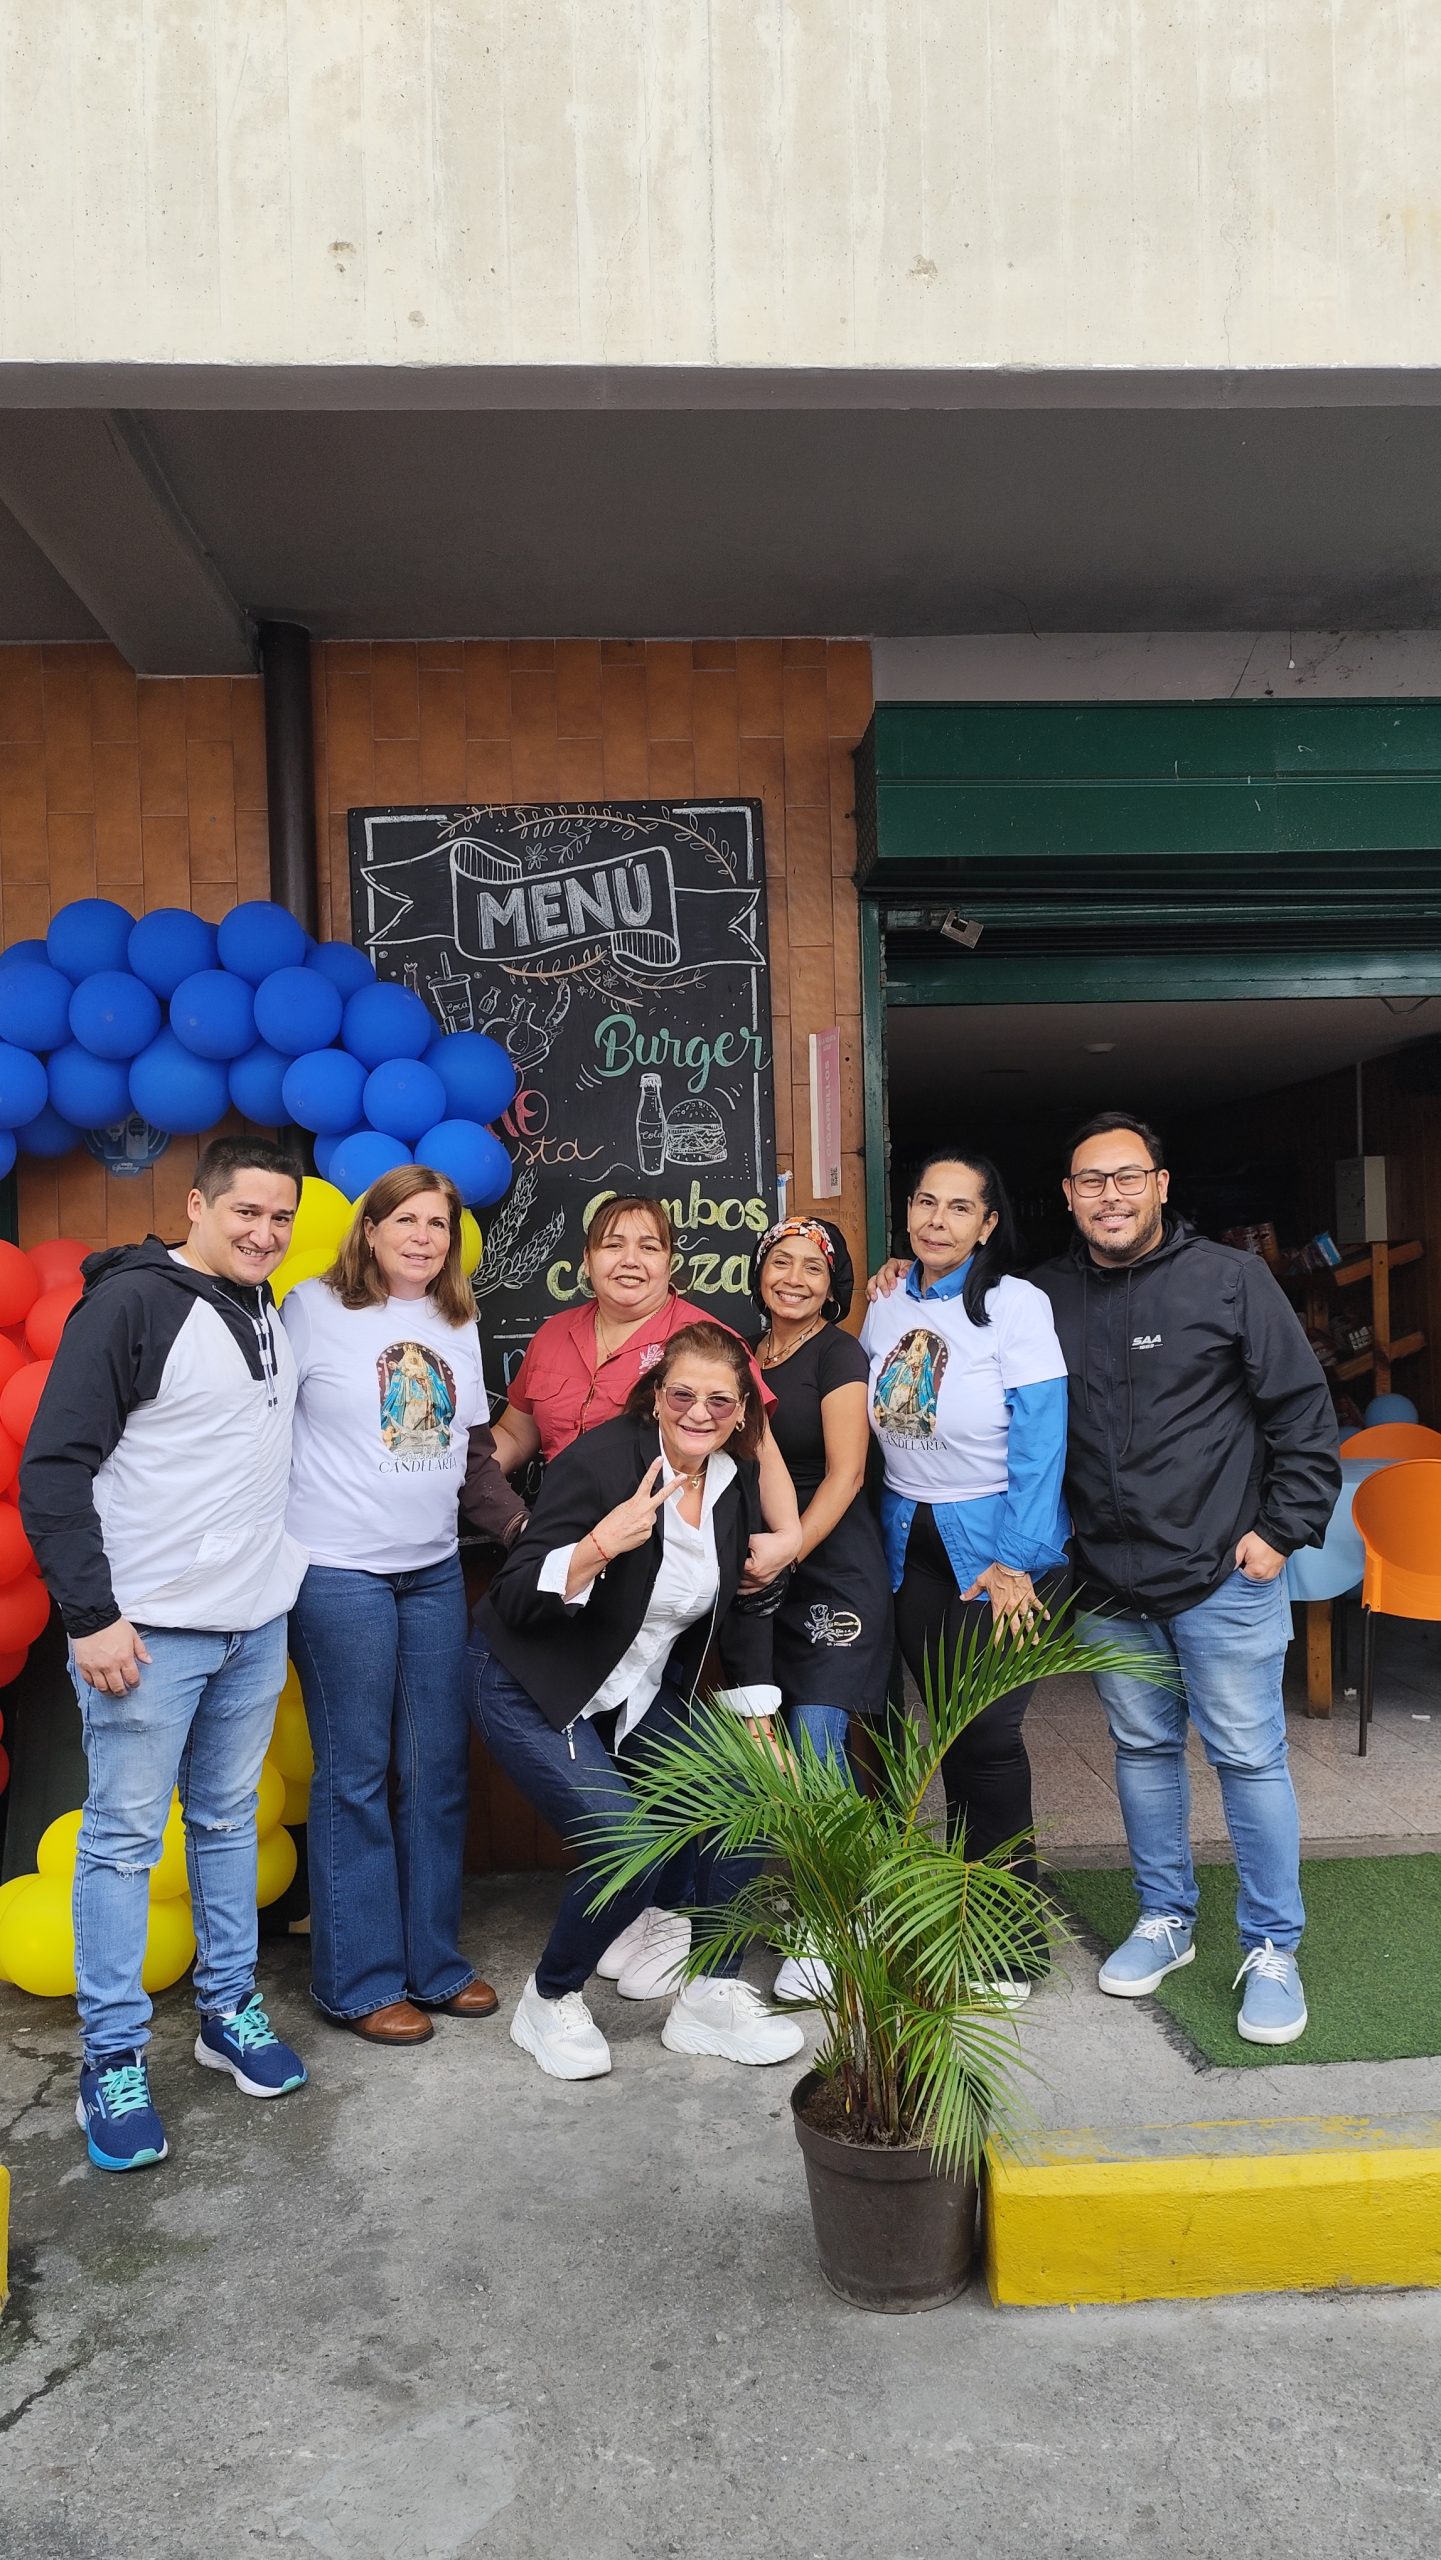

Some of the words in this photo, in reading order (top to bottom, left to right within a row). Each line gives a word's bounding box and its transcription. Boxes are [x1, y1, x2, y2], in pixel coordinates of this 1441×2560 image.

[477, 858, 652, 950] MENÚ
[445, 1001, 470, 1014] Coca
[594, 1013, 771, 1093] Burger
[823, 1060, 832, 1159] CIGARRILLOS
[583, 1179, 769, 1232] Cmbos
[546, 1252, 752, 1300] ceeza
[1131, 1334, 1162, 1346] SAA
[378, 1456, 457, 1474] CANDELARIA
